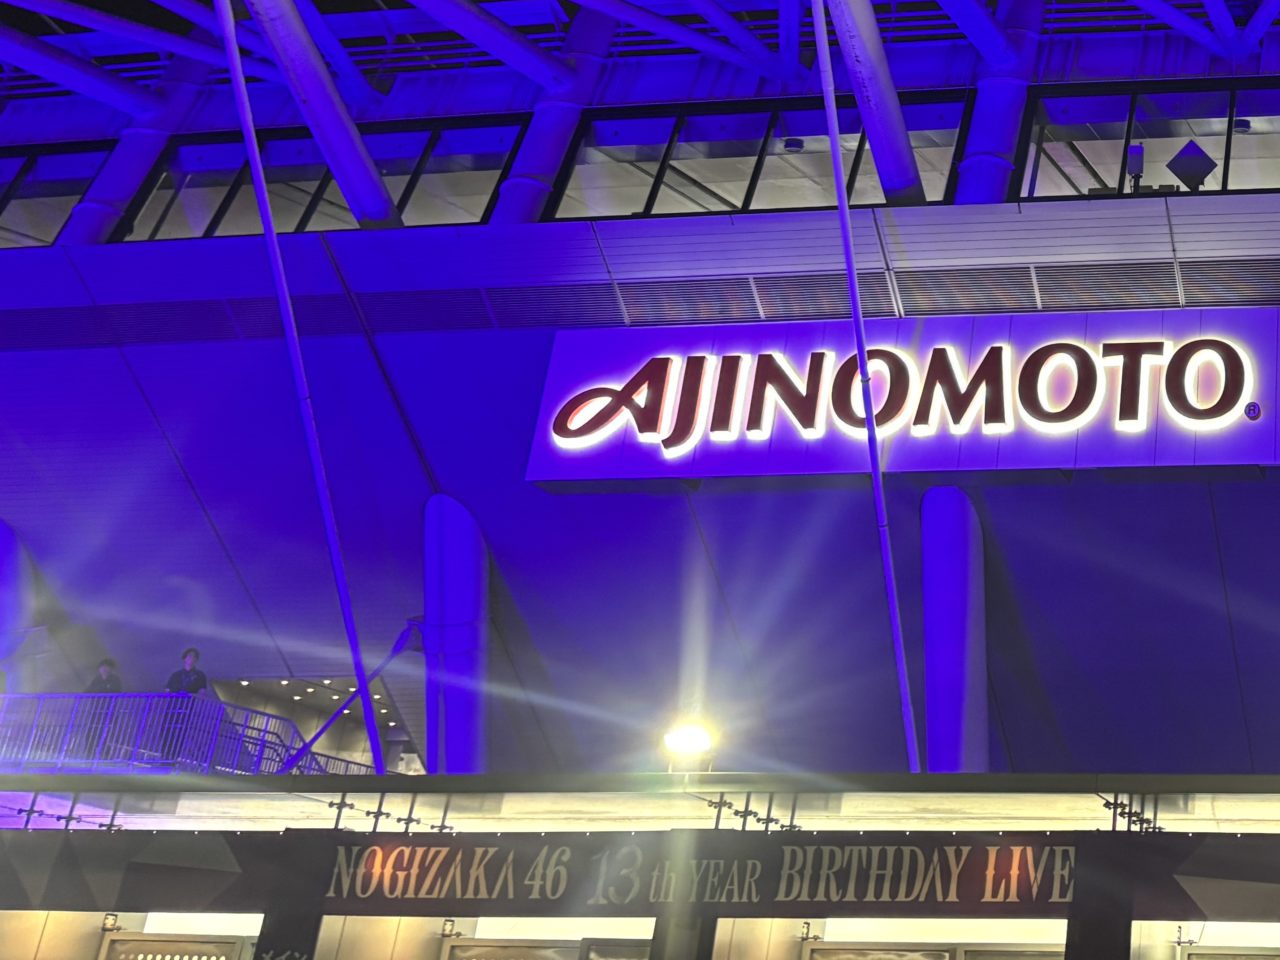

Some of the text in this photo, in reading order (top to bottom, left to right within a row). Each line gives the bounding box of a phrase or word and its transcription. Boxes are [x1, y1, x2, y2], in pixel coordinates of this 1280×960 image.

[325, 844, 515, 899] NOGIZAKA
[524, 844, 571, 900] 46
[586, 843, 644, 905] 13
[688, 859, 762, 903] YEAR
[774, 845, 973, 903] BIRTHDAY
[980, 845, 1076, 903] LIVE
